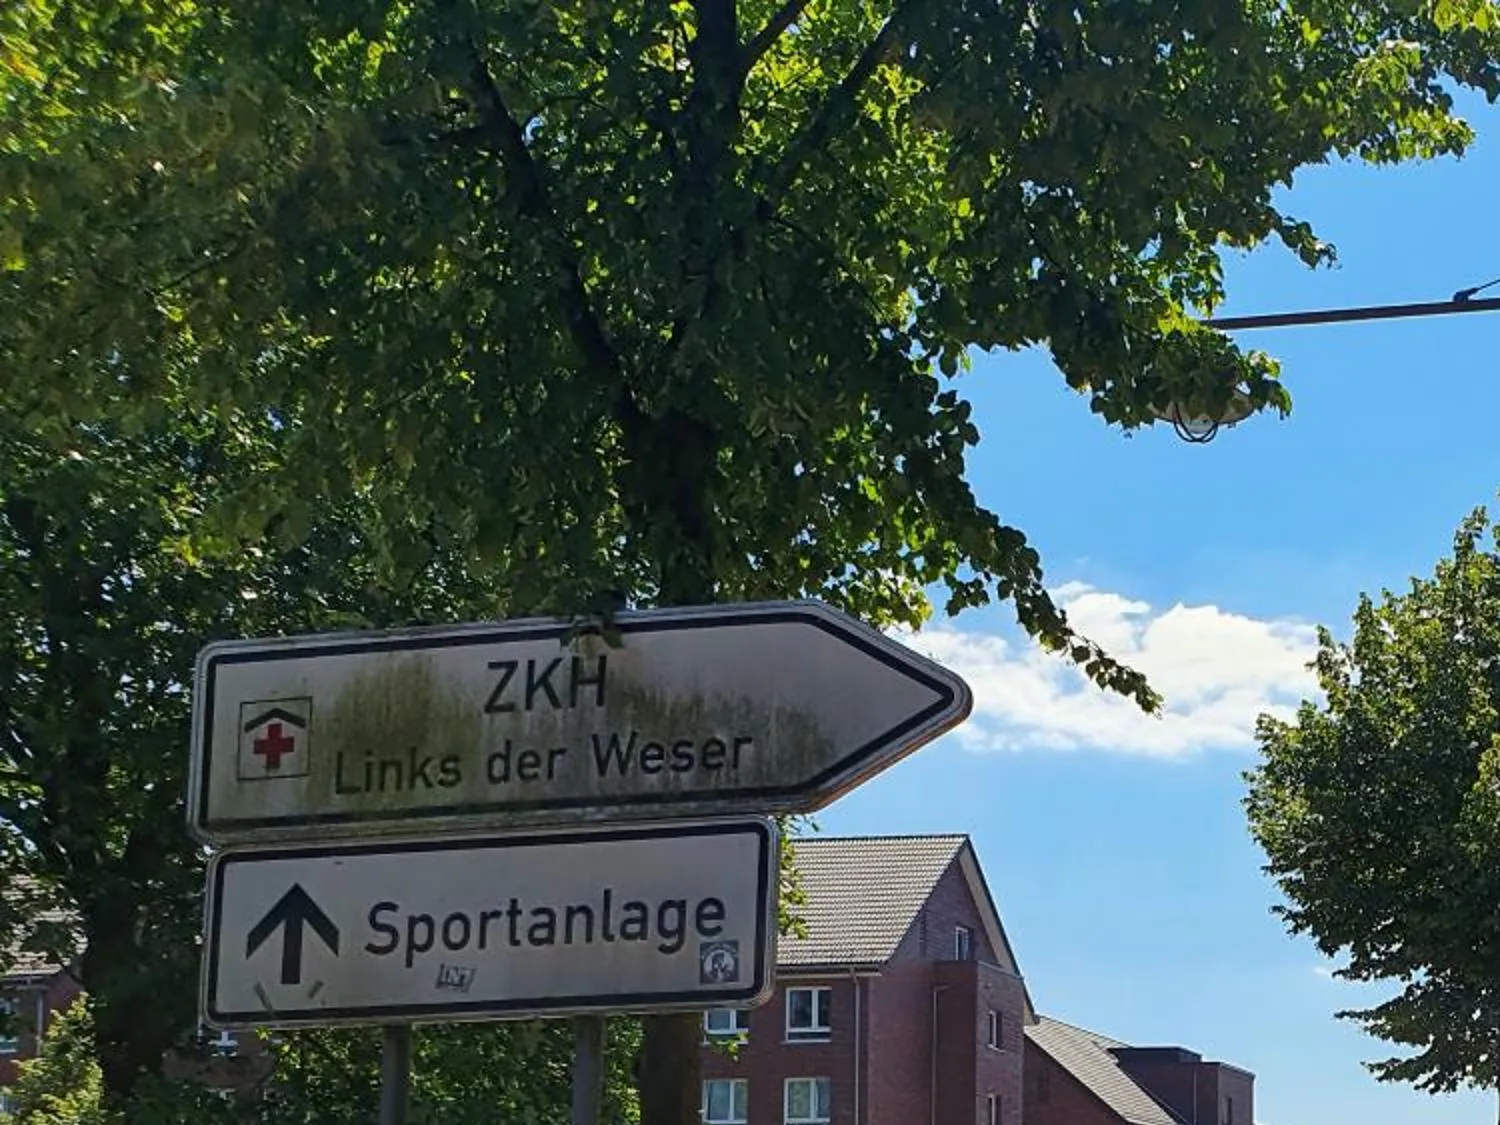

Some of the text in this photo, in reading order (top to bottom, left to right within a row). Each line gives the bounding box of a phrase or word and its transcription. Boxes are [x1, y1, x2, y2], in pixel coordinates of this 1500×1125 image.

[483, 654, 608, 713] ZKH
[335, 731, 752, 795] Links der Weser
[365, 888, 726, 968] Sportanlage
